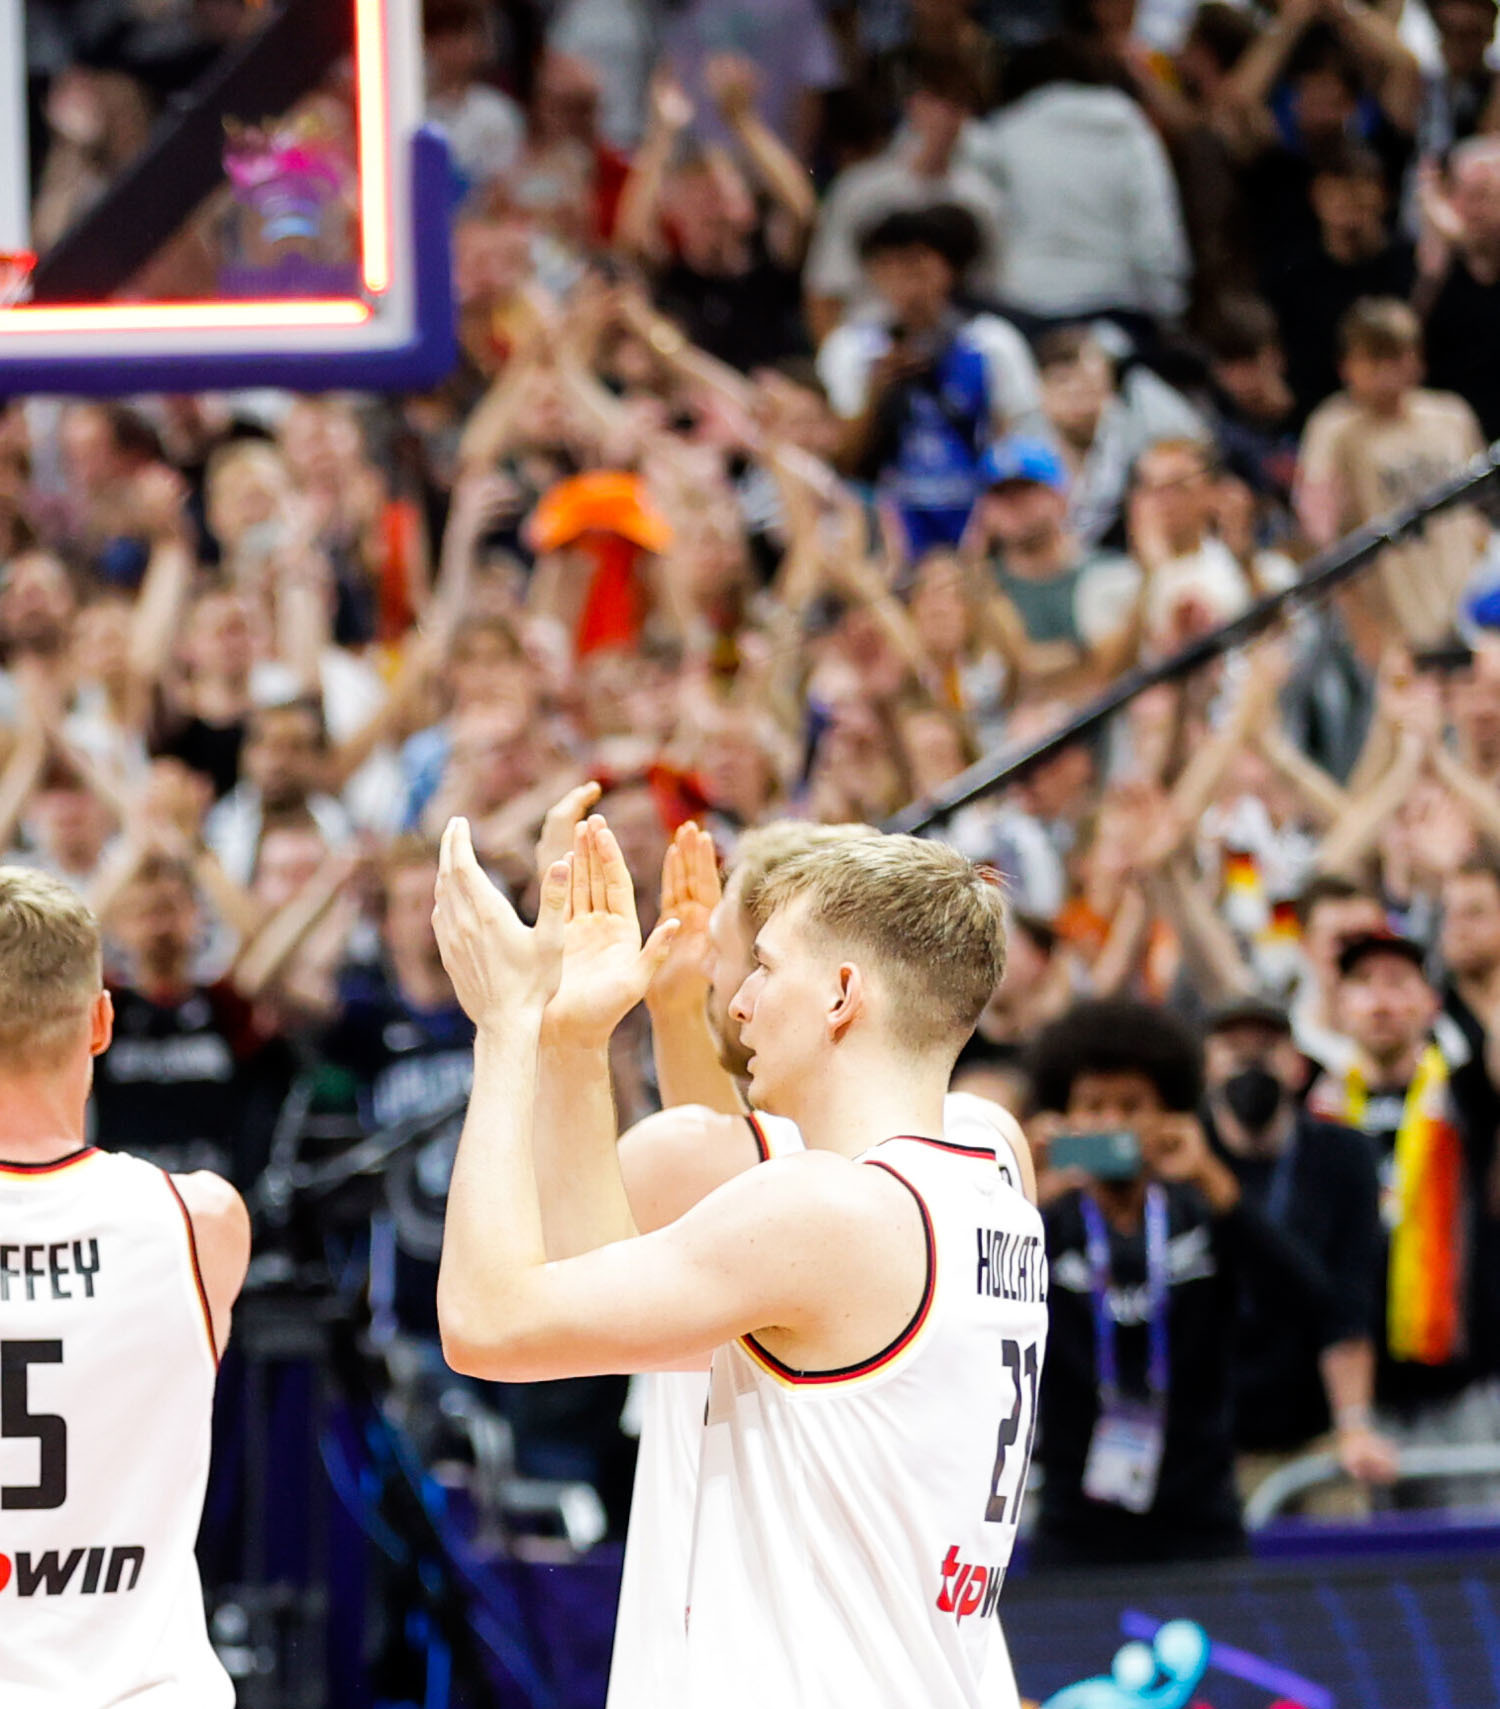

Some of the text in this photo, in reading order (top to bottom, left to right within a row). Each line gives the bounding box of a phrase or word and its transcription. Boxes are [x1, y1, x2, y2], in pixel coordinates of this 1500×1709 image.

[0, 1339, 68, 1511] 5
[984, 1339, 1038, 1525] 21
[935, 1545, 1007, 1628] tipw
